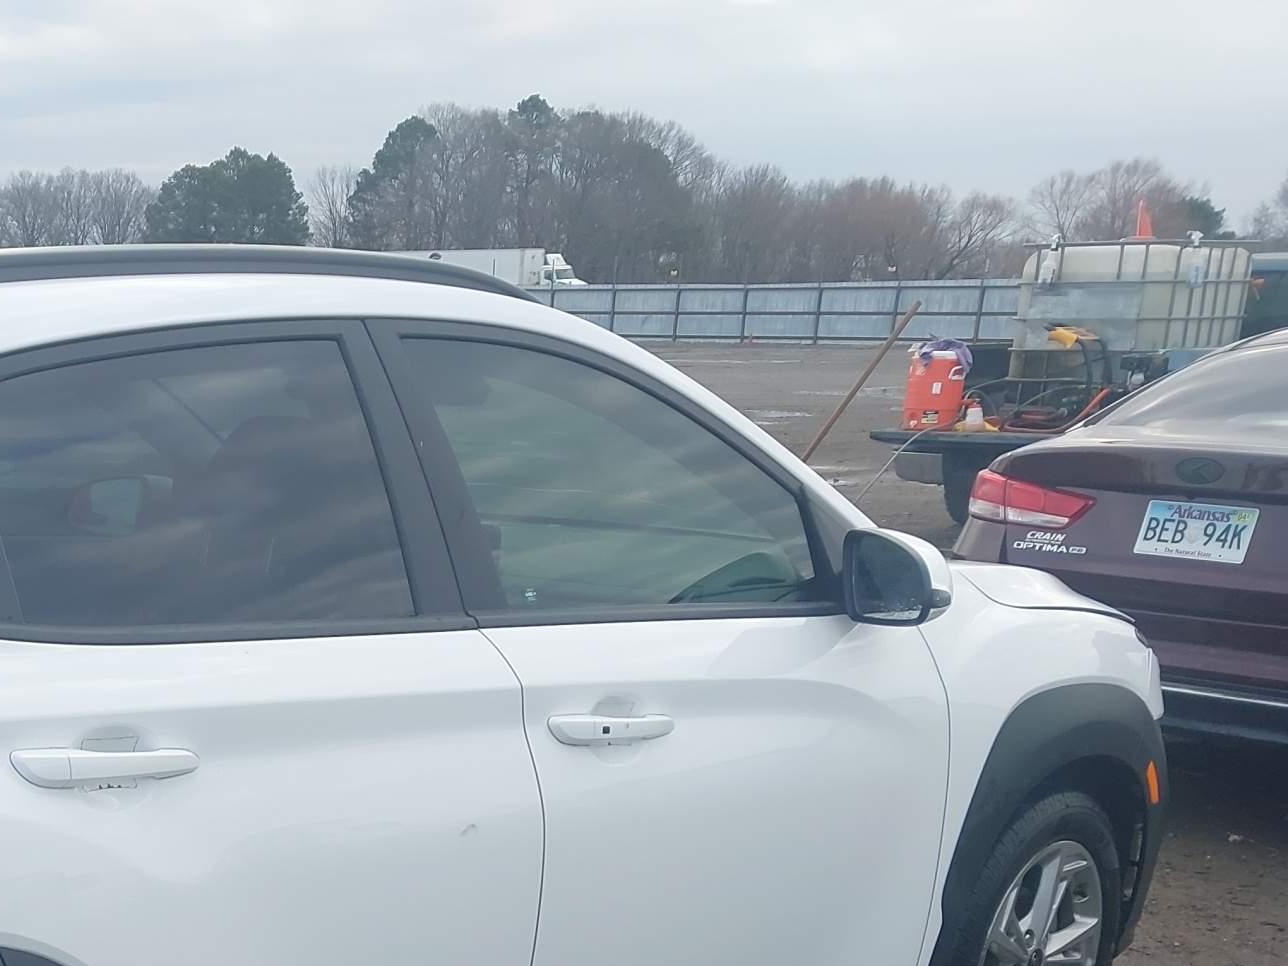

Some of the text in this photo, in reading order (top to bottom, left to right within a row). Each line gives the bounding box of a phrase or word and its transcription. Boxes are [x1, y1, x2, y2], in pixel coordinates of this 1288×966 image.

[1170, 504, 1232, 523] Arkansas
[1026, 530, 1067, 541] CRAIN
[1142, 516, 1248, 550] BEB 94K
[1013, 540, 1068, 553] OPTIMA
[1175, 548, 1196, 557] Natural
